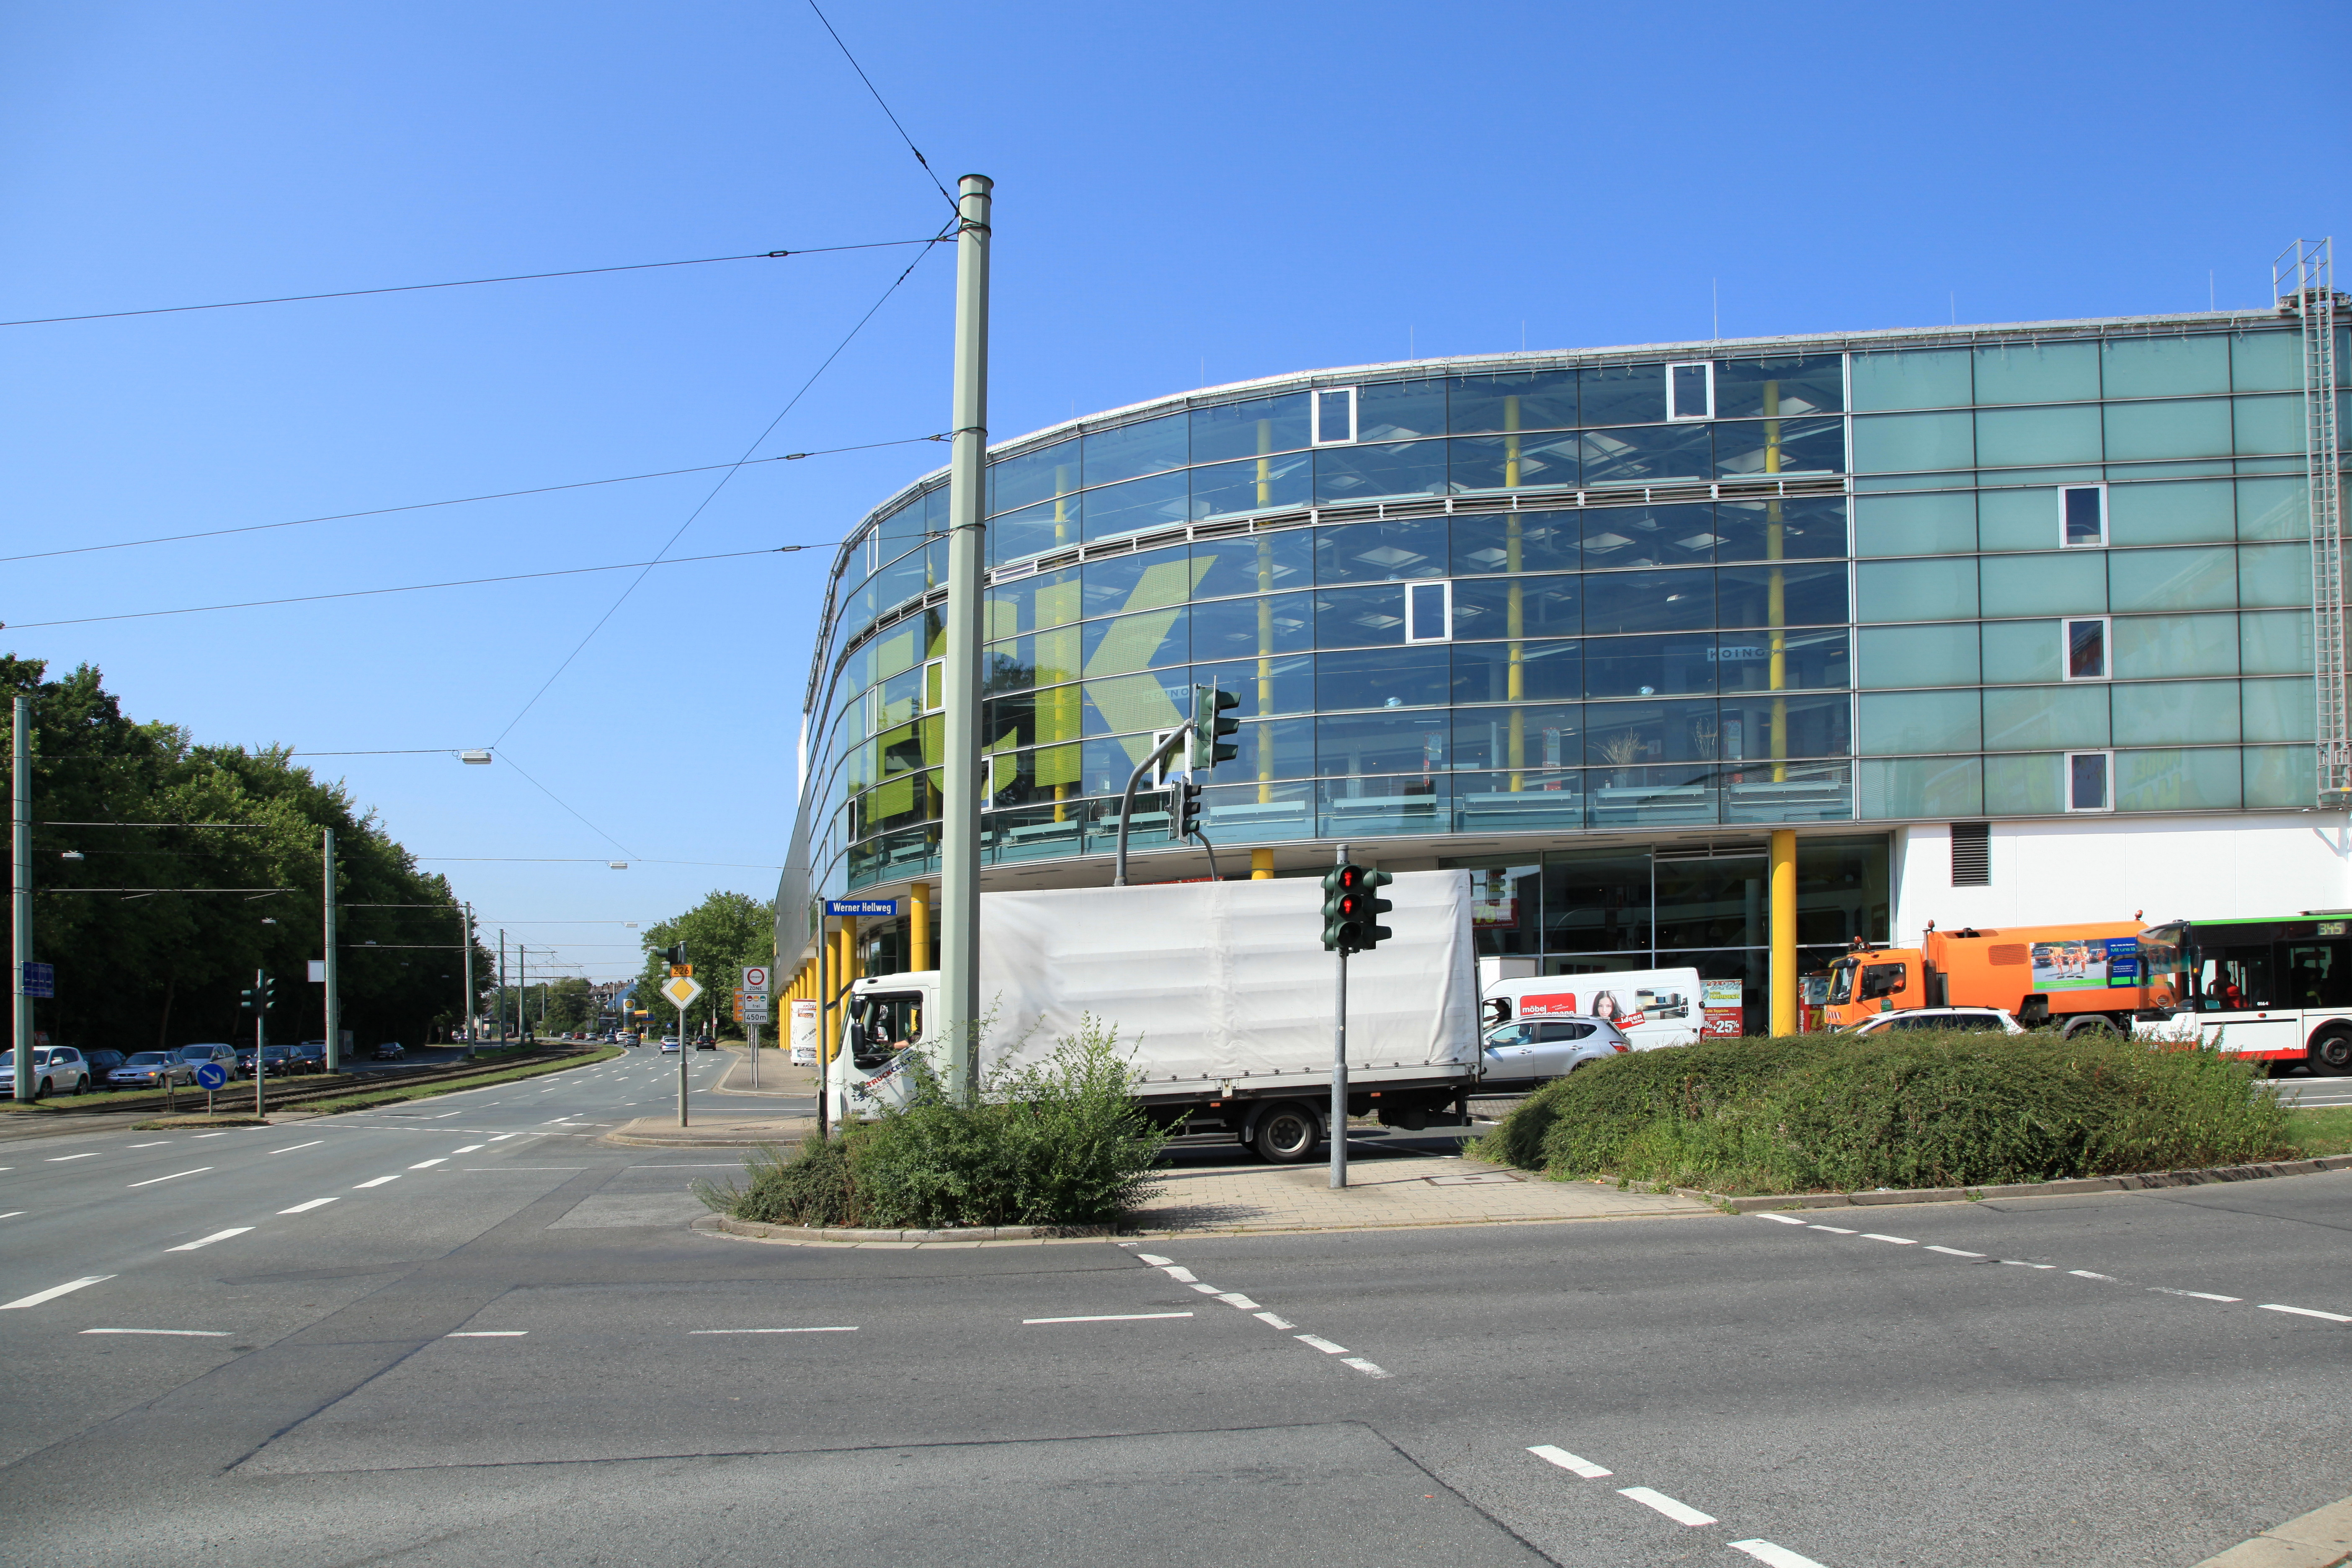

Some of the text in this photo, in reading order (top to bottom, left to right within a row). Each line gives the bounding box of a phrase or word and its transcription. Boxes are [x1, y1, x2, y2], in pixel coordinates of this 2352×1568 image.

[1710, 648, 1765, 659] KOINO
[833, 903, 891, 914] Werner Hellweg
[1474, 905, 1496, 923] 75
[2319, 923, 2342, 935] 345
[1710, 981, 1741, 990] JAHRE
[1800, 978, 1827, 996] 75
[1522, 1005, 1546, 1014] möbel
[1621, 1014, 1643, 1023] Ideen
[869, 1069, 881, 1079] AUTO
